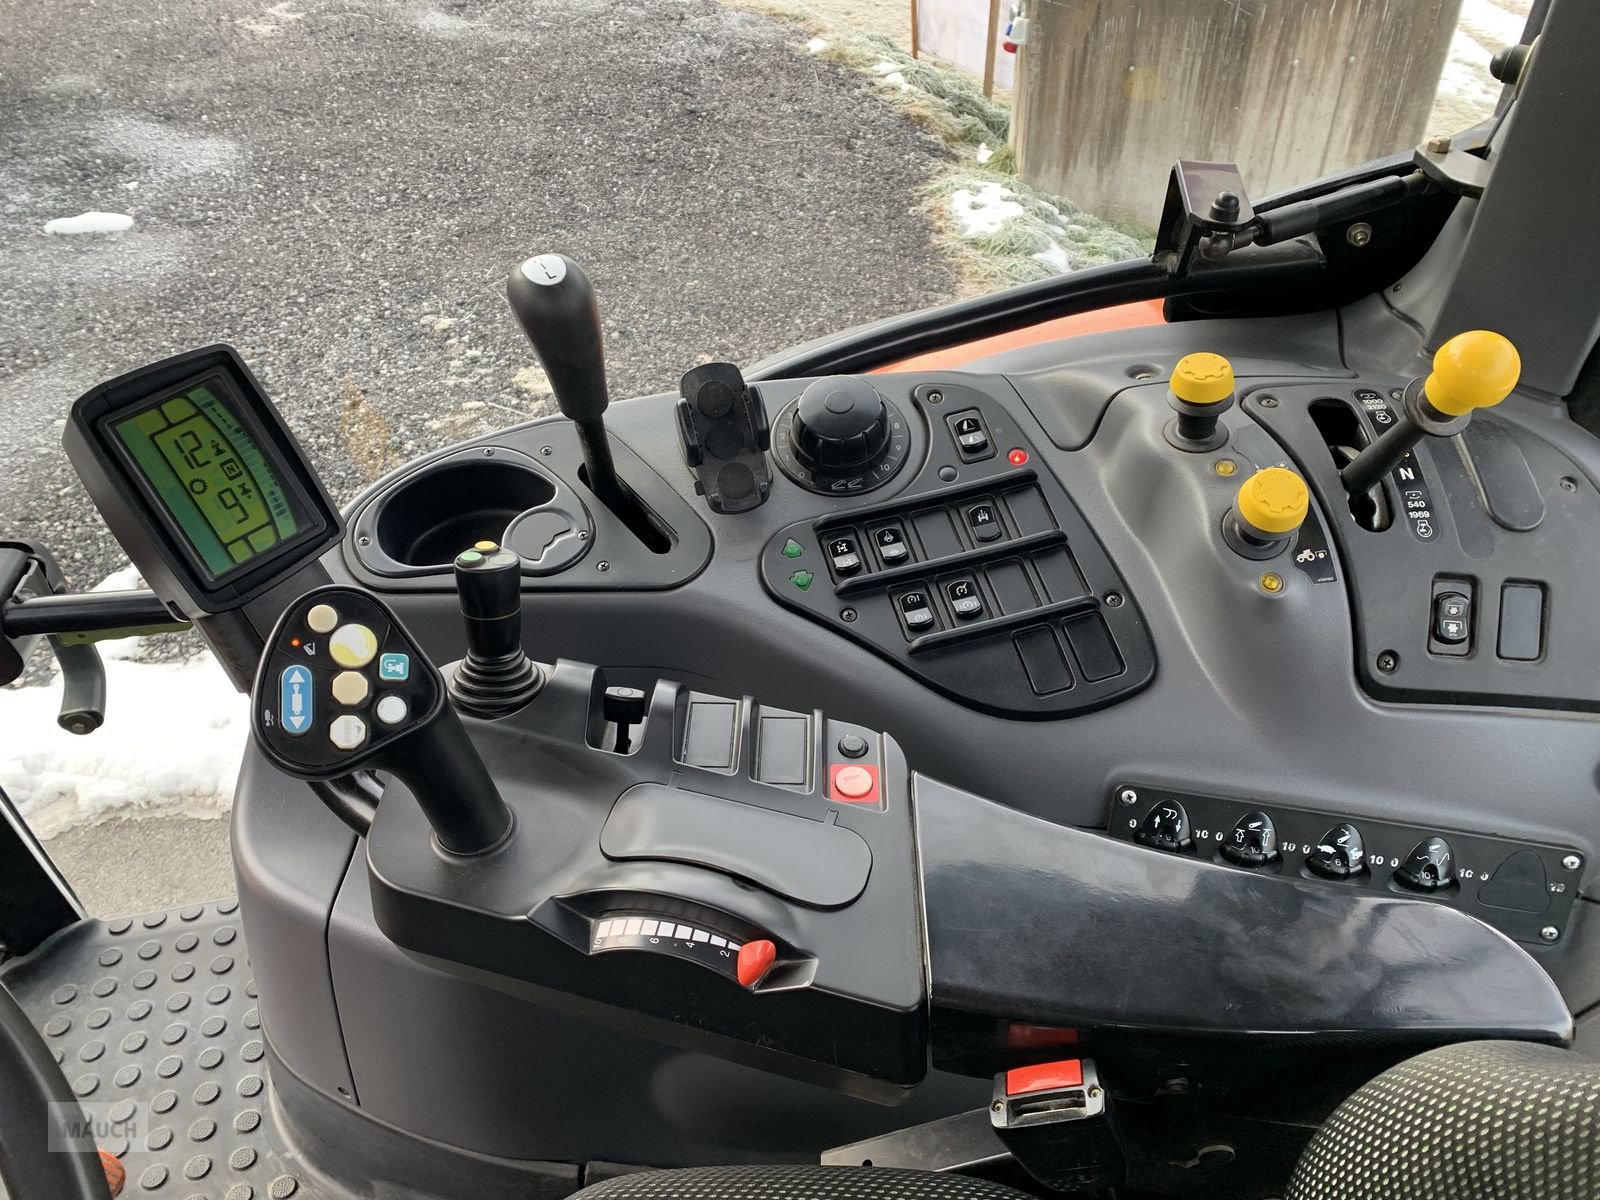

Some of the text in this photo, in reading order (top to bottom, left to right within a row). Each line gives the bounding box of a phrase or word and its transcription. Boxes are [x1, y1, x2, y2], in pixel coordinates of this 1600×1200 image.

[174, 430, 211, 470] 12
[880, 463, 890, 471] 10
[1399, 467, 1415, 480] N
[217, 487, 249, 524] 9
[1407, 500, 1426, 508] 540
[1408, 510, 1430, 518] 1969
[1129, 818, 1137, 828] 0
[1195, 829, 1209, 839] 10
[1215, 831, 1224, 841] 0
[1282, 841, 1296, 852] 10
[1302, 844, 1312, 854] 0
[1370, 854, 1384, 865] 10
[1390, 857, 1399, 867] 0
[1421, 871, 1431, 880] 10
[1459, 868, 1474, 878] 10
[686, 941, 696, 949] 4
[719, 949, 731, 958] 2
